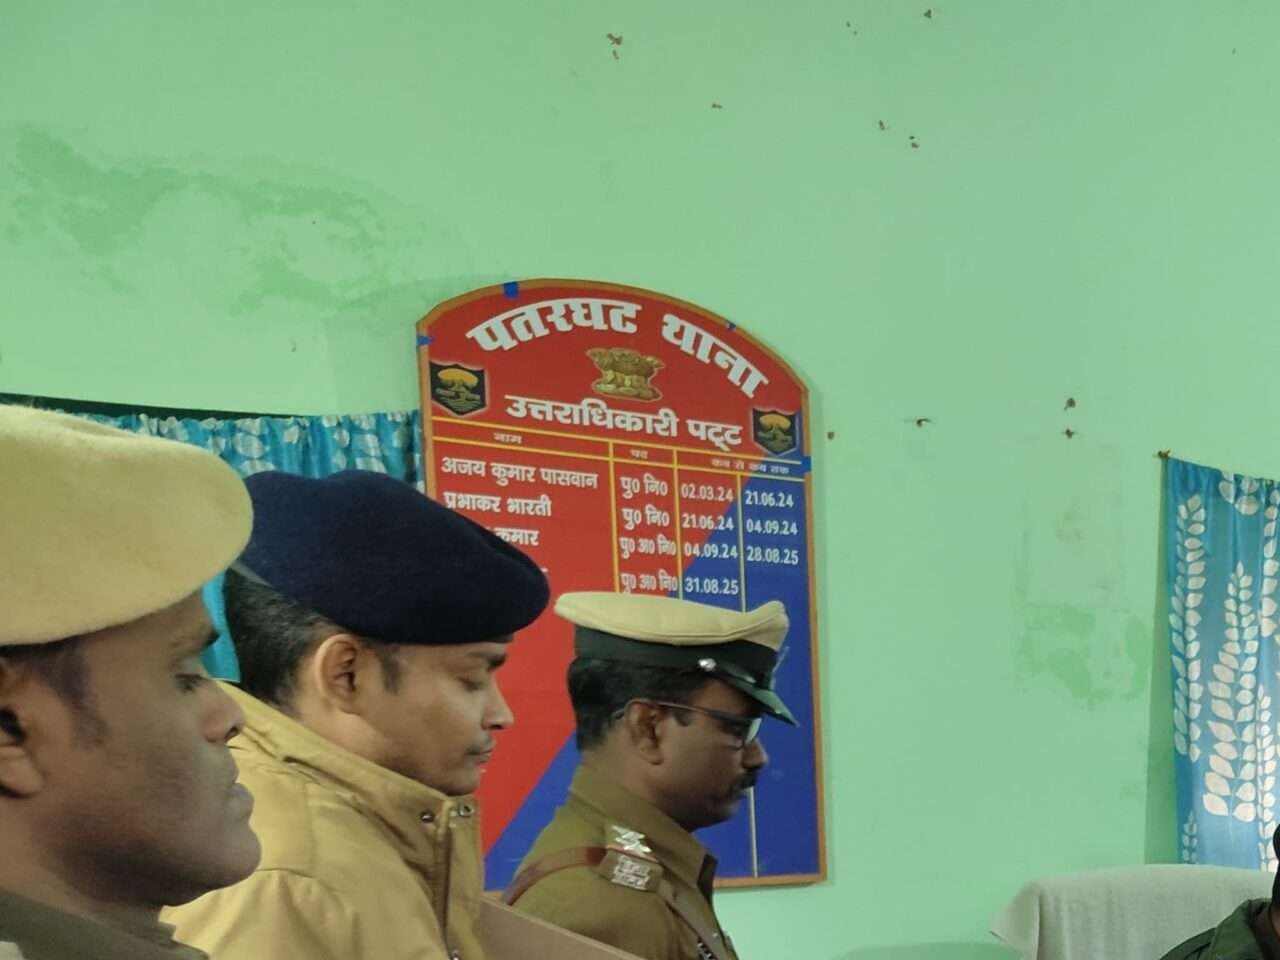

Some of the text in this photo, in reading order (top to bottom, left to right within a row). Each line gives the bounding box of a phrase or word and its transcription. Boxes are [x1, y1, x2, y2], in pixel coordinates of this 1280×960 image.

[465, 297, 769, 399] पतरघट थाना
[504, 394, 680, 437] उत्तराधिकारी
[493, 432, 522, 444] नाम
[441, 456, 599, 489] अजय कुमार पासवान
[681, 482, 735, 502] 02.03.24
[744, 489, 794, 508] 21.06.24
[443, 491, 552, 517] प्रभाकर भारती
[682, 513, 735, 531] 21.06.24
[746, 518, 798, 536] 04.09.24
[493, 527, 540, 546] कमार
[683, 542, 738, 559] 04.09.24
[746, 546, 799, 566] 28.08.25
[685, 576, 739, 596] 31.08.25
